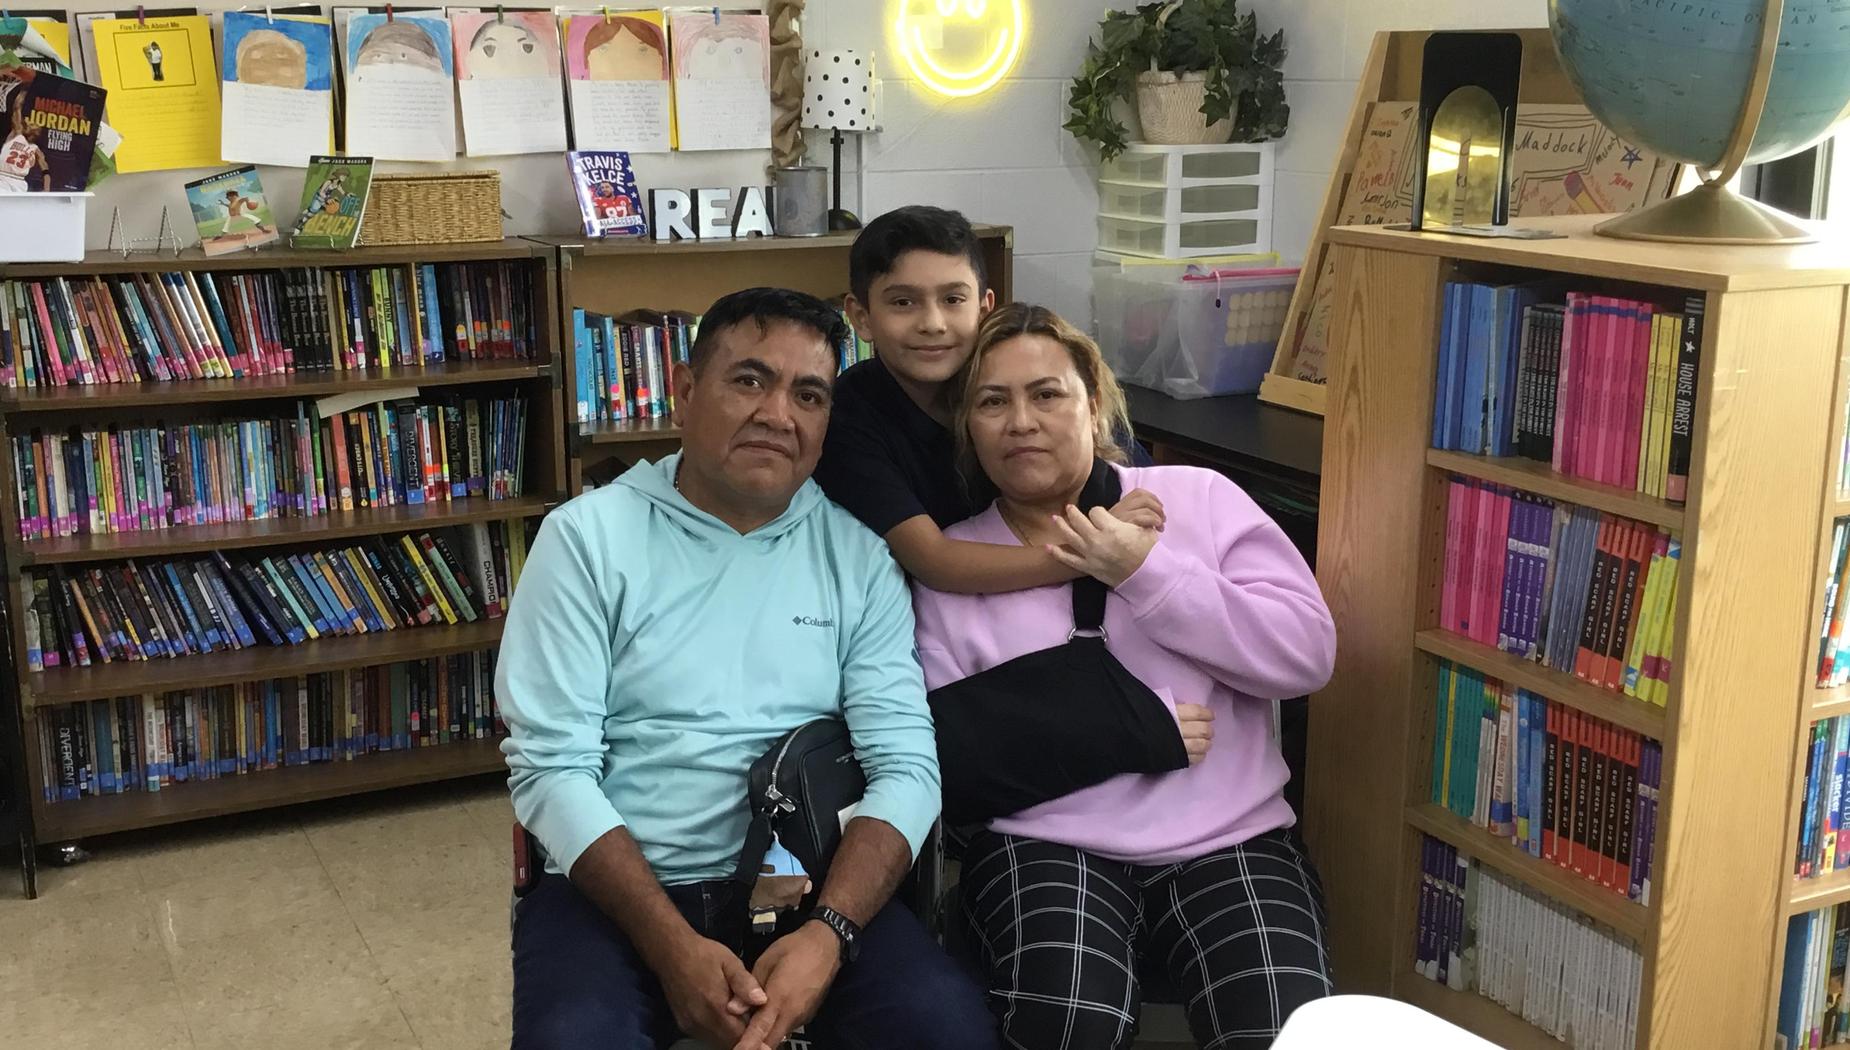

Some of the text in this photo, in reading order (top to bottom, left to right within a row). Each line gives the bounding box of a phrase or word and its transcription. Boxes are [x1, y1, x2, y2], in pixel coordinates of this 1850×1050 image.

[34, 96, 86, 118] MICHAEL
[25, 110, 91, 136] JORDAN
[48, 130, 73, 141] FLYING
[47, 139, 71, 152] HIGH
[1516, 131, 1587, 154] Maddock
[6, 151, 29, 169] 23
[577, 155, 623, 171] TRAVIS
[583, 169, 625, 186] KELCE
[304, 213, 358, 237] BENCH
[1673, 362, 1695, 437] HOUSE ARREST
[404, 431, 419, 488] DIVERGENT
[1585, 561, 1604, 639] RED SCARF GIRL
[1599, 567, 1618, 645] RED SCARF GIRL
[1616, 570, 1635, 649] RED SCARF GIRL
[59, 727, 75, 786] DIVERGENT
[1495, 735, 1507, 783] WEDNESDAY
[1580, 757, 1588, 774] RED
[1494, 785, 1504, 801] WA
[1579, 778, 1587, 806] SCARF
[1593, 786, 1601, 813] SCARF
[1608, 791, 1616, 819] SCARF
[1832, 774, 1843, 812] slacker
[1623, 798, 1632, 826] SCARF
[1591, 818, 1599, 840] GIRL
[1621, 831, 1629, 854] GIRL
